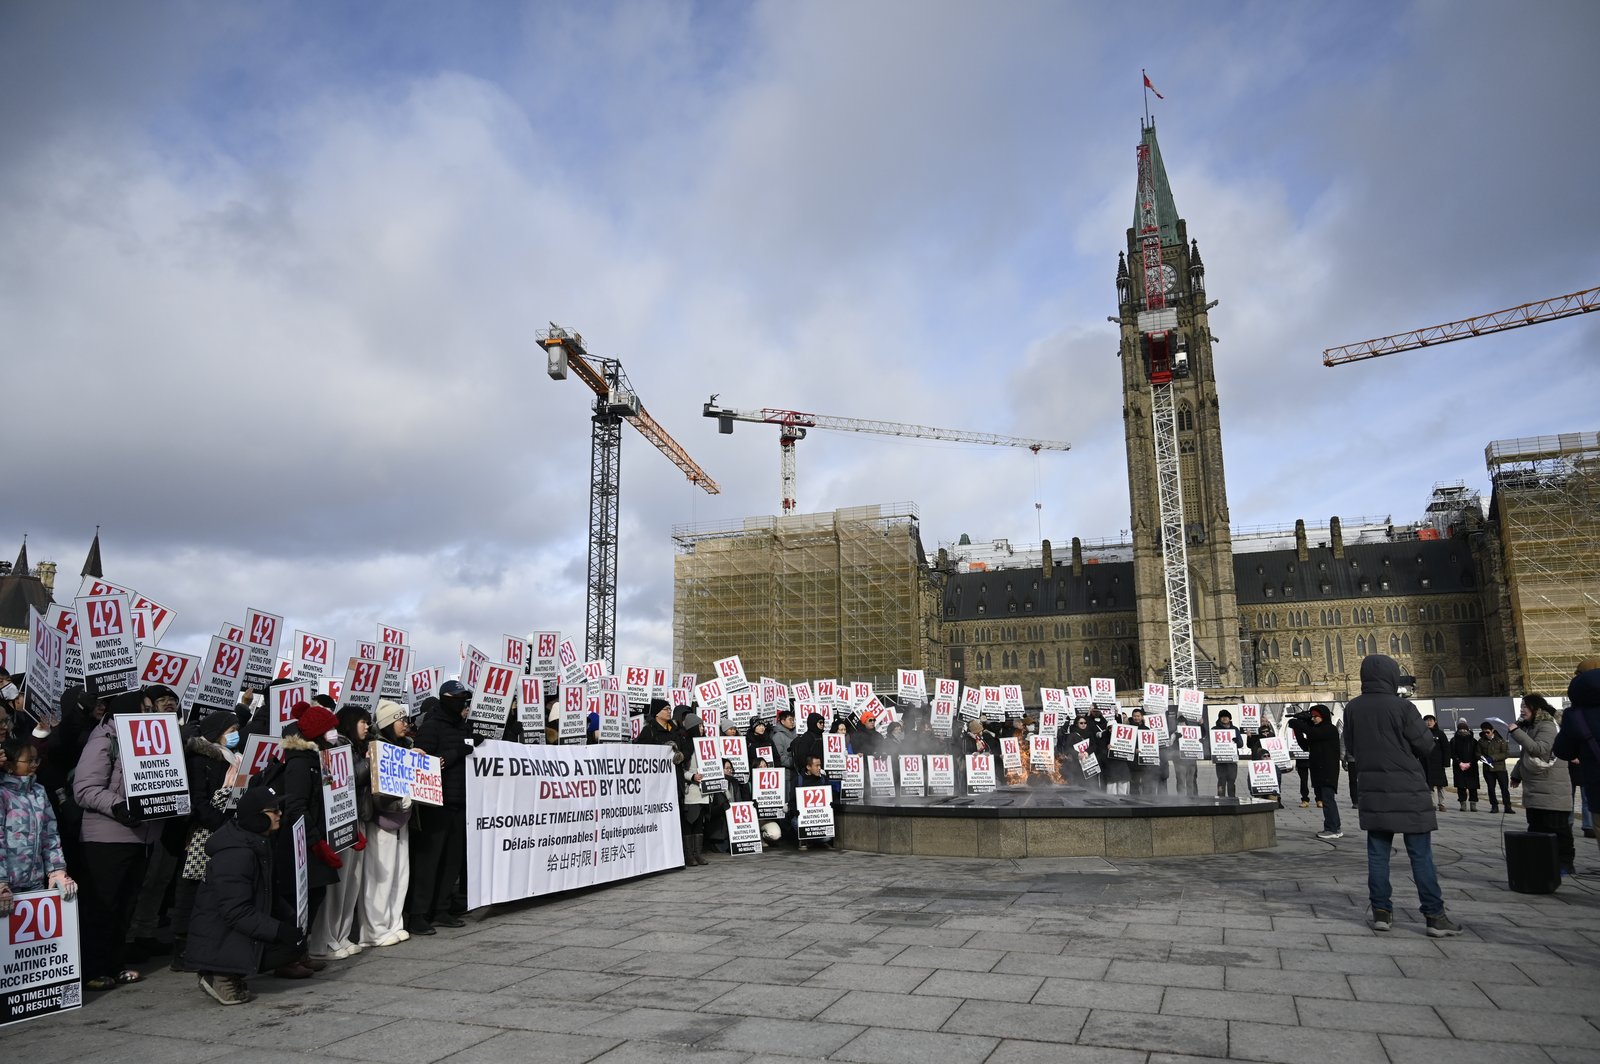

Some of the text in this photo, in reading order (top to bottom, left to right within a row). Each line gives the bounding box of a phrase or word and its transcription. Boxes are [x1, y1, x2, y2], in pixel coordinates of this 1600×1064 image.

[93, 600, 120, 635] 42
[253, 616, 273, 645] 42
[38, 625, 52, 664] 20
[96, 638, 121, 649] MONTHS
[304, 637, 324, 664] 22
[540, 635, 554, 656] 53
[90, 647, 129, 660] WAITING FOR
[363, 646, 374, 659] 39
[387, 647, 401, 671] 31
[509, 641, 520, 664] 15
[560, 643, 573, 666] 68
[88, 661, 102, 672] IRCC
[104, 656, 133, 669] RESPONSE
[217, 644, 240, 677] 32
[263, 657, 271, 665] FOR
[148, 655, 183, 684] 39
[249, 662, 272, 674] RESPONSE
[298, 670, 317, 679] WAITING
[303, 664, 322, 673] MONTHS
[584, 664, 599, 679] 20
[724, 660, 737, 677] 43
[96, 672, 127, 684] NO TIMELINE
[212, 677, 232, 688] MONTHS
[355, 664, 374, 691] 31
[414, 672, 430, 694] 28
[487, 668, 508, 694] 11
[629, 669, 648, 685] 33
[905, 672, 916, 685] 70
[107, 680, 127, 690] RESULTS
[204, 685, 234, 697] WAITING FOR
[524, 680, 538, 703] 71
[702, 682, 720, 700] 30
[820, 682, 831, 695] 27
[857, 684, 867, 698] 16
[941, 681, 953, 694] 36
[1096, 680, 1110, 692] 38
[1150, 685, 1164, 696] 32
[198, 693, 210, 702] IRCC
[210, 695, 234, 707] RESPONSE
[483, 696, 502, 704] MONTHS
[568, 687, 581, 711] 53
[674, 690, 686, 706] 34
[765, 687, 774, 702] 65
[837, 688, 847, 700] 27
[968, 690, 979, 704] 28
[986, 689, 999, 701] 37
[1005, 687, 1018, 699] 90
[1046, 690, 1059, 701] 39
[476, 703, 494, 712] WAITING
[606, 694, 618, 716] 34
[735, 695, 751, 711] 55
[868, 698, 881, 718] 35
[937, 702, 950, 715] 31
[481, 712, 505, 720] RESPONSE
[703, 710, 715, 724] 30
[1244, 706, 1256, 716] 37
[1044, 714, 1055, 726] 31
[1150, 717, 1162, 729] 38
[136, 721, 166, 755] 40
[1117, 726, 1132, 740] 37
[1142, 732, 1154, 743] 37
[1183, 728, 1197, 739] 40
[1216, 732, 1230, 742] 31
[703, 740, 714, 759] 41
[726, 739, 740, 755] 24
[829, 736, 841, 752] 34
[1005, 741, 1016, 754] 37
[1035, 738, 1049, 750] 37
[140, 759, 170, 769] MONTHS
[383, 744, 429, 770] STOP THE
[975, 756, 988, 770] 14
[331, 752, 348, 788] 40
[473, 757, 672, 777] WE DEMAND A TIMELY DECISION
[846, 758, 859, 772] 35
[875, 759, 887, 772] 18
[905, 758, 918, 771] 36
[935, 758, 948, 771] 21
[1255, 763, 1270, 774] 22
[134, 769, 178, 781] WAITING FOR
[762, 772, 777, 789] 40
[131, 779, 184, 792] IRCC RESPONSE
[540, 778, 641, 800] DELAYED BY IRCC
[140, 798, 149, 806] NO
[333, 790, 349, 801] MONTHS
[806, 789, 824, 807] 22
[144, 804, 177, 815] NO RESULTS
[330, 802, 346, 813] WAITING
[337, 807, 356, 821] RESPONSE
[734, 805, 751, 823] 43
[477, 803, 673, 830] REASONABLE TIMELINES PROCEDURAL FAIRNESS
[503, 823, 658, 851] Délais raisonnables Équité procédurale
[547, 843, 635, 872] 给出时限 程序公平
[15, 897, 56, 942] 20
[15, 943, 57, 959] MONTHS
[4, 954, 68, 975] WAITING FOR
[22, 965, 74, 984] RESPONSE
[8, 995, 20, 1005] NO
[12, 997, 62, 1015] NO RESULTS
